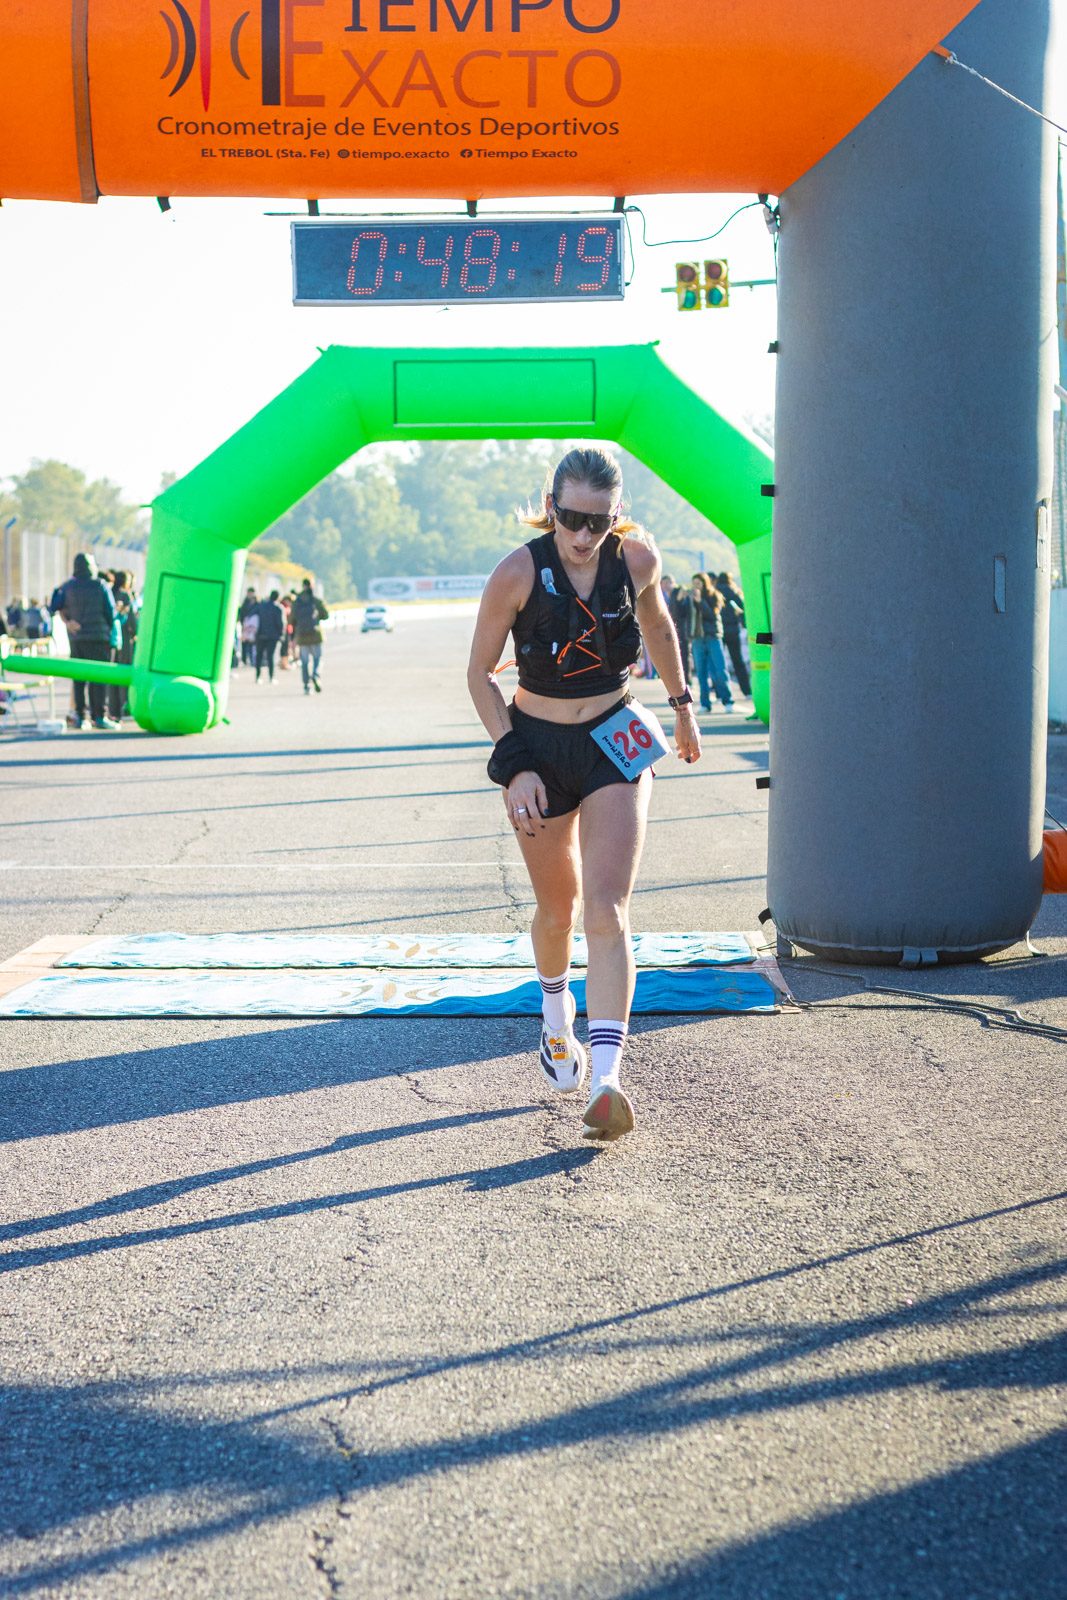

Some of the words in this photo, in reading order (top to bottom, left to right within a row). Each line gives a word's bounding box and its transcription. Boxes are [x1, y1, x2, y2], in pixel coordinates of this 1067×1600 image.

[284, 0, 622, 109] EXACTO
[157, 116, 327, 140] Cronometraje
[334, 117, 365, 136] de
[373, 117, 472, 136] Eventos
[480, 117, 620, 140] Deportivos
[201, 149, 217, 158] EL
[219, 149, 273, 158] TREBOL
[276, 149, 307, 159] (Sta.
[310, 149, 330, 159] Fe)
[352, 149, 450, 160] tiempo.exacto
[475, 149, 528, 160] Tiempo
[532, 149, 578, 158] Exacto
[347, 227, 614, 295] 0:48:19
[602, 735, 631, 768] TIEMPO
